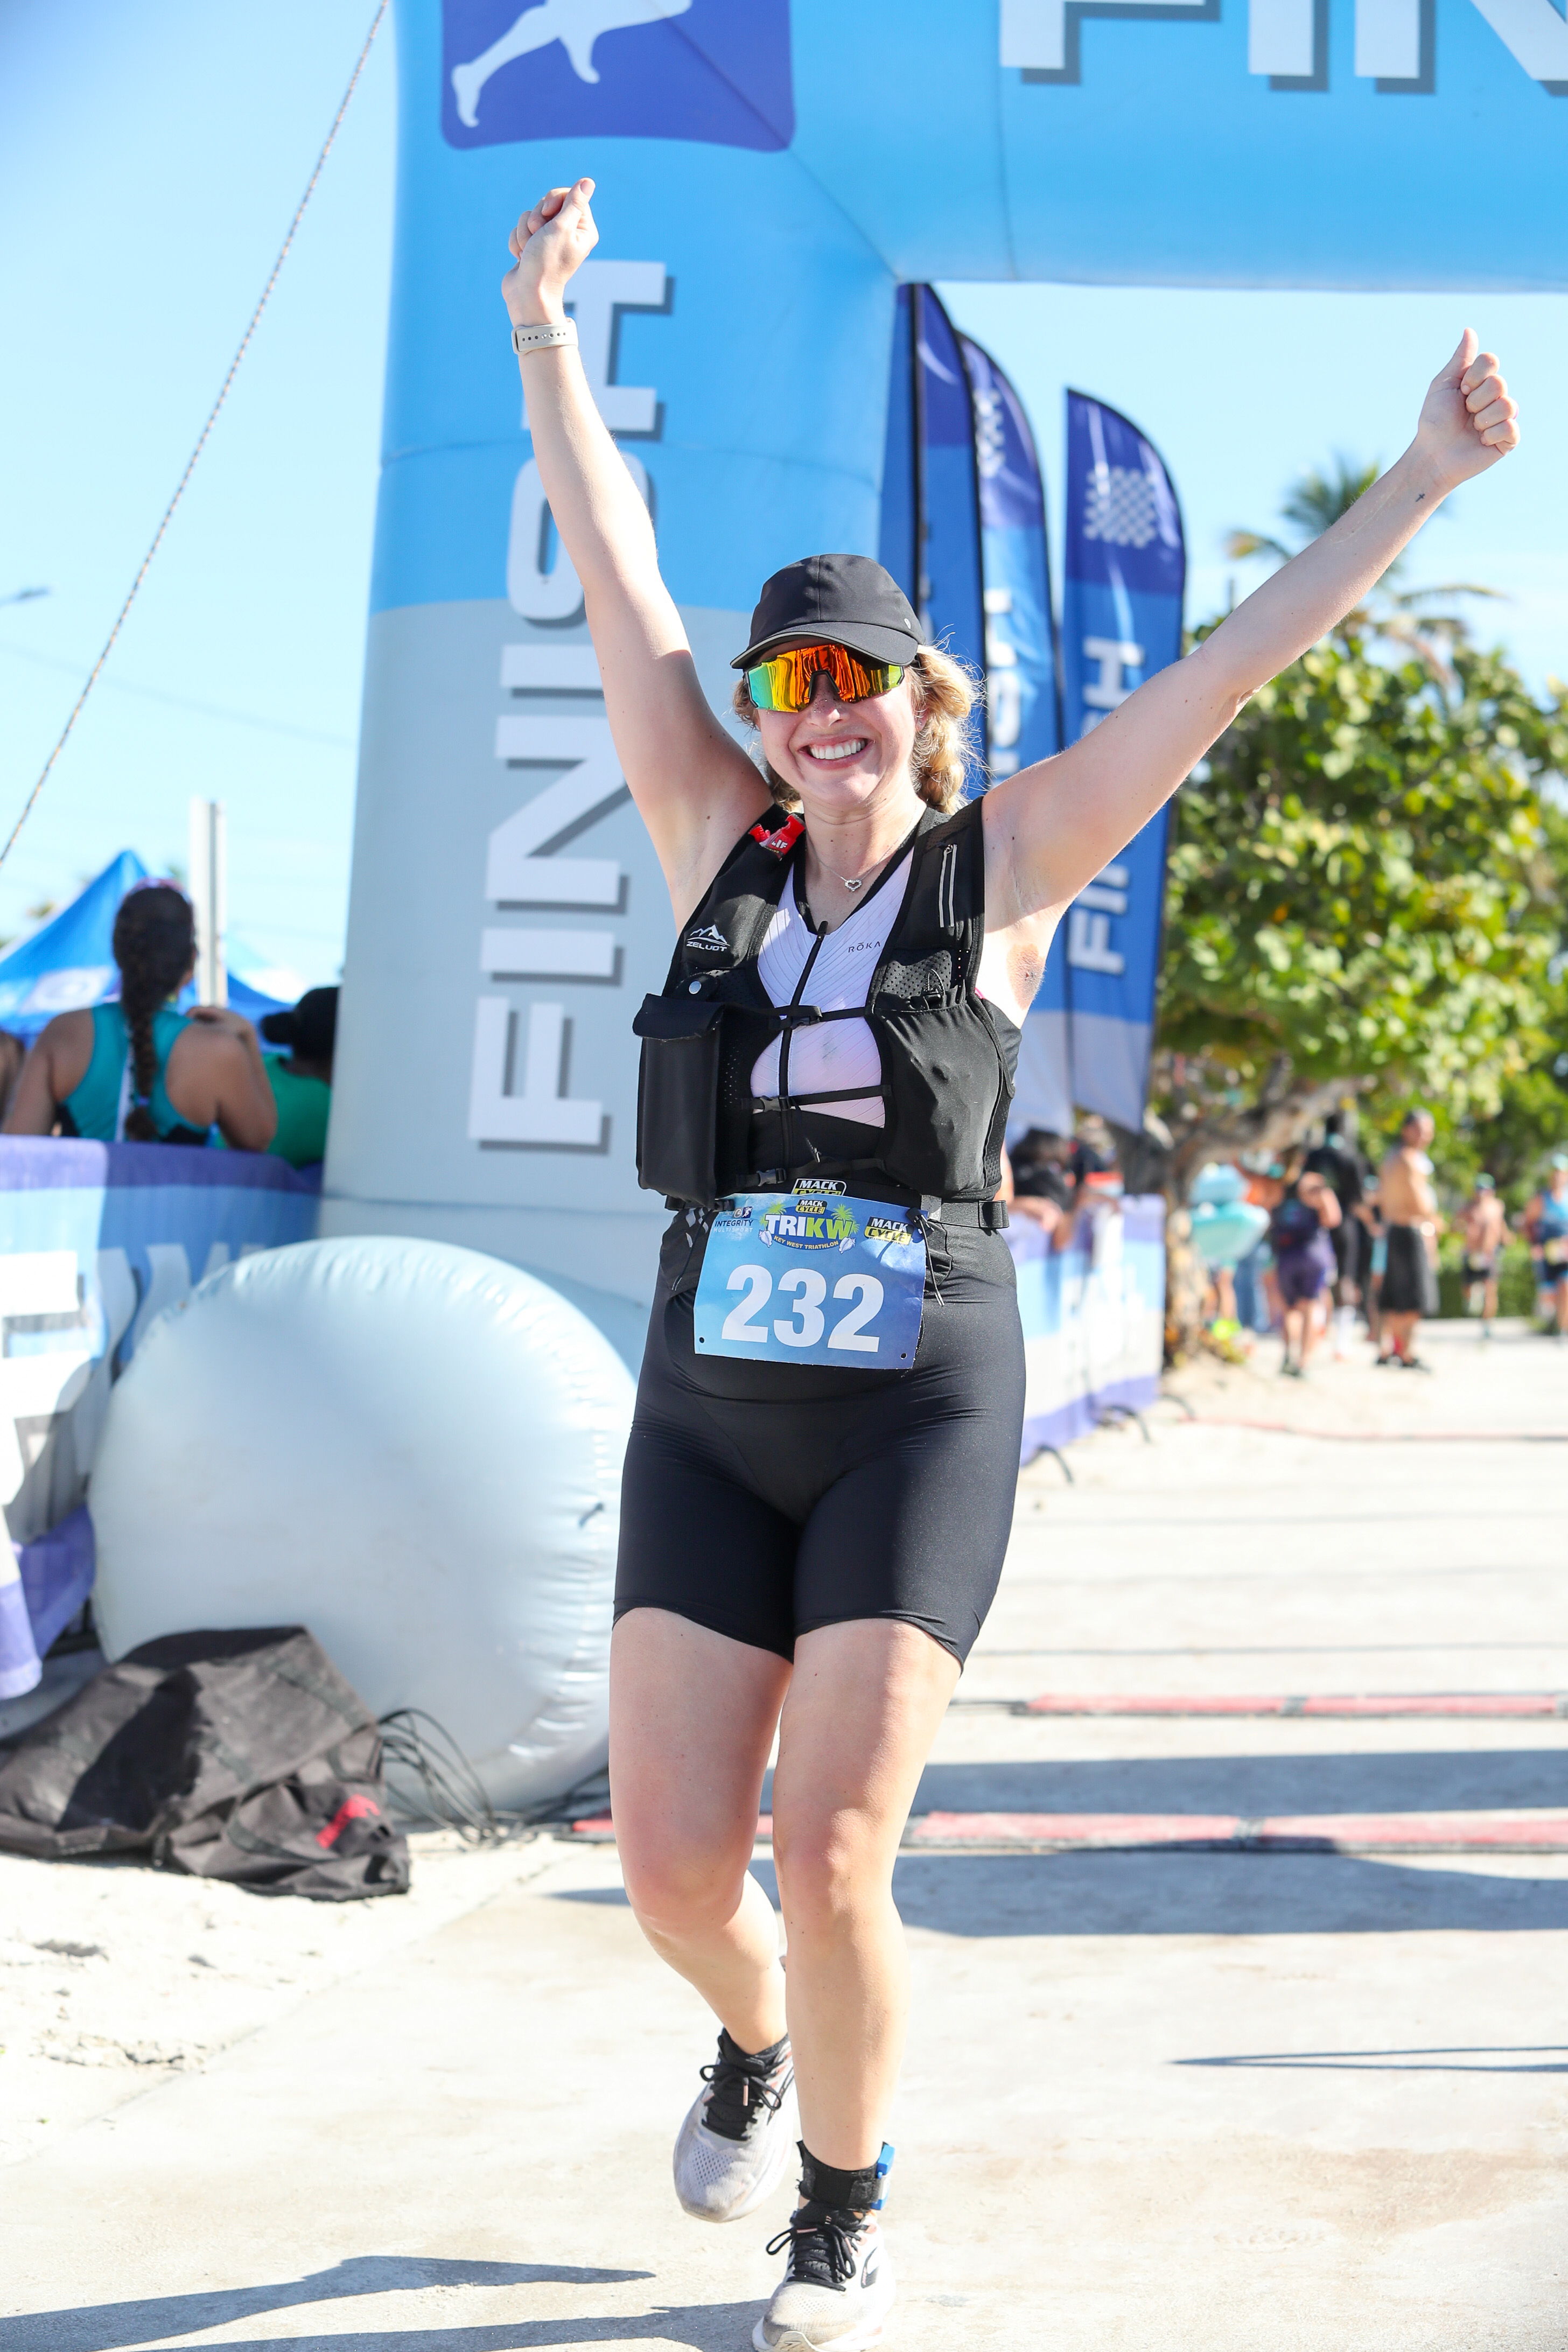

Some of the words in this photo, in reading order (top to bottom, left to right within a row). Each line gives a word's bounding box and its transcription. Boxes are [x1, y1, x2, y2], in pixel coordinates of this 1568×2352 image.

[800, 1180, 838, 1190] MACK
[765, 1214, 853, 1240] TRIKW
[871, 1218, 908, 1233] MACK
[804, 1241, 839, 1249] TRIATHLON
[721, 1264, 884, 1353] 232
